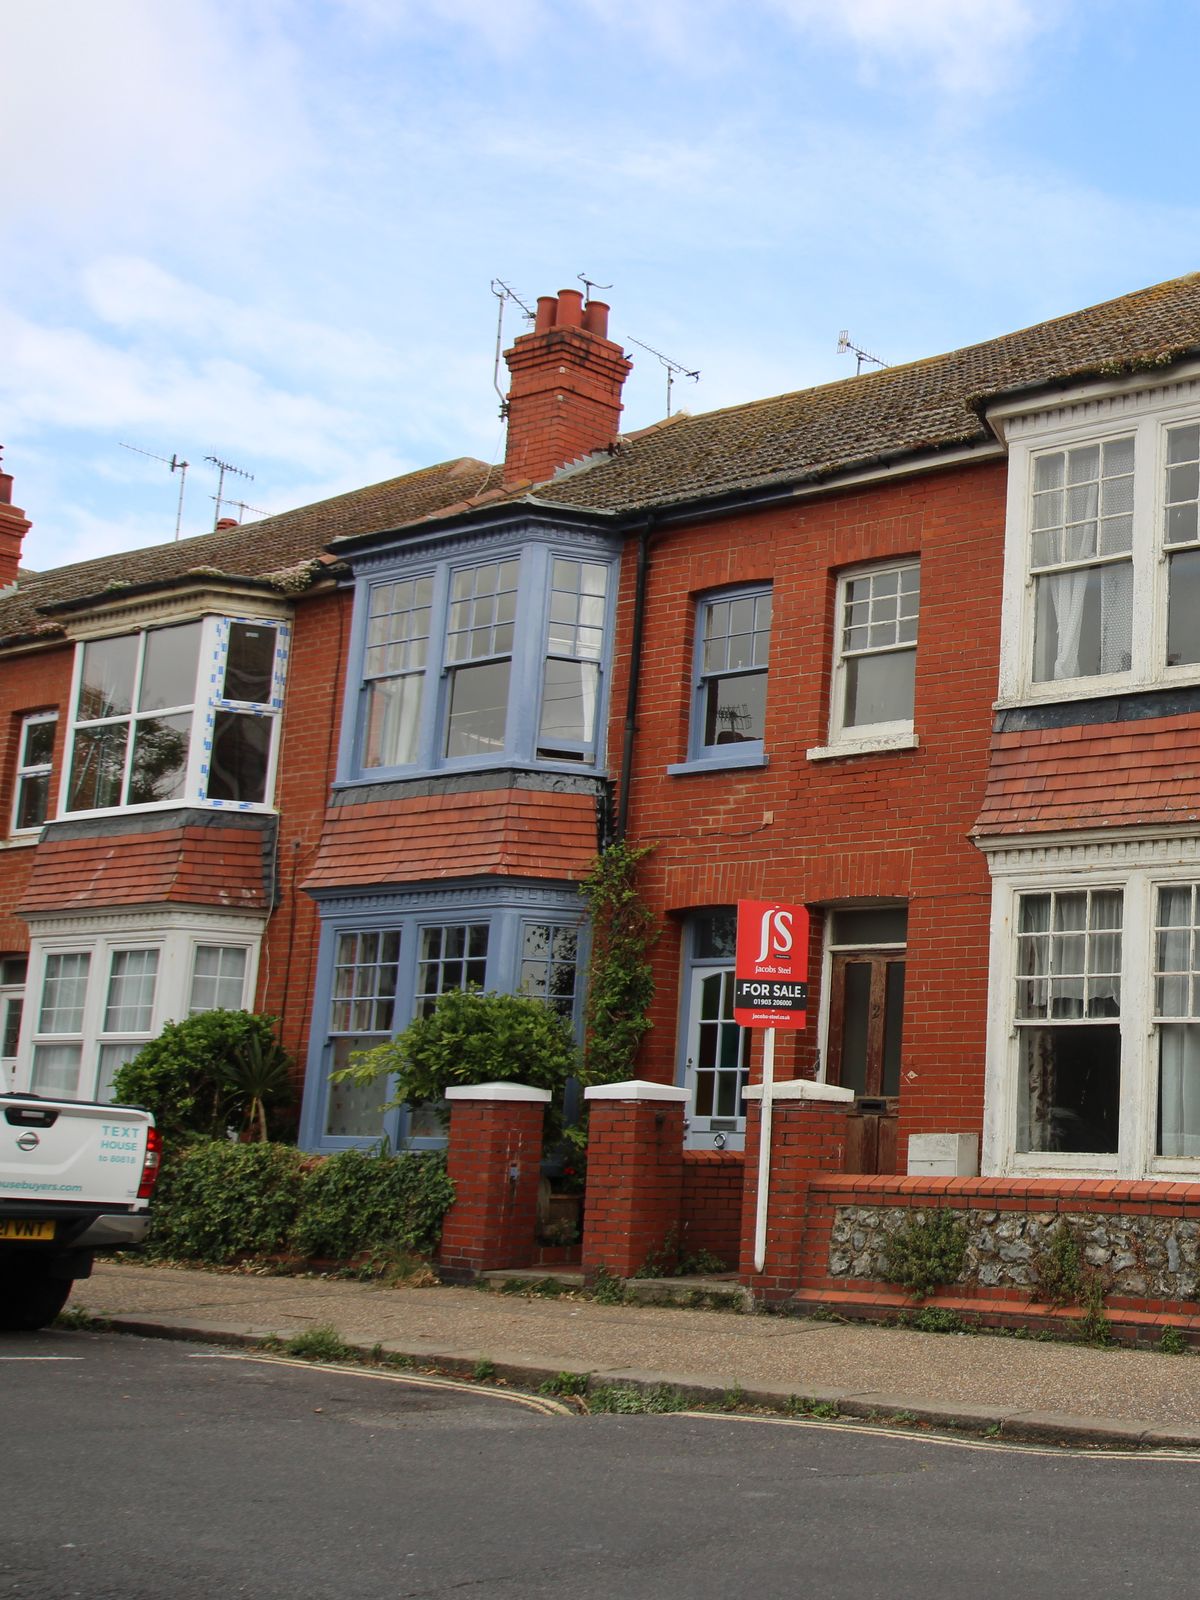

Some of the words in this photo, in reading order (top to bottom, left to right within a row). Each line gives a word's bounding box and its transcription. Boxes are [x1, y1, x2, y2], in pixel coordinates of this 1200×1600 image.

[755, 965, 776, 974] Jacobs
[778, 966, 792, 975] Steel
[742, 983, 770, 996] FOR
[773, 985, 802, 998] SALE
[102, 1125, 140, 1138] TEXT
[101, 1140, 137, 1151] HOUSE
[14, 1221, 43, 1237] VNT
